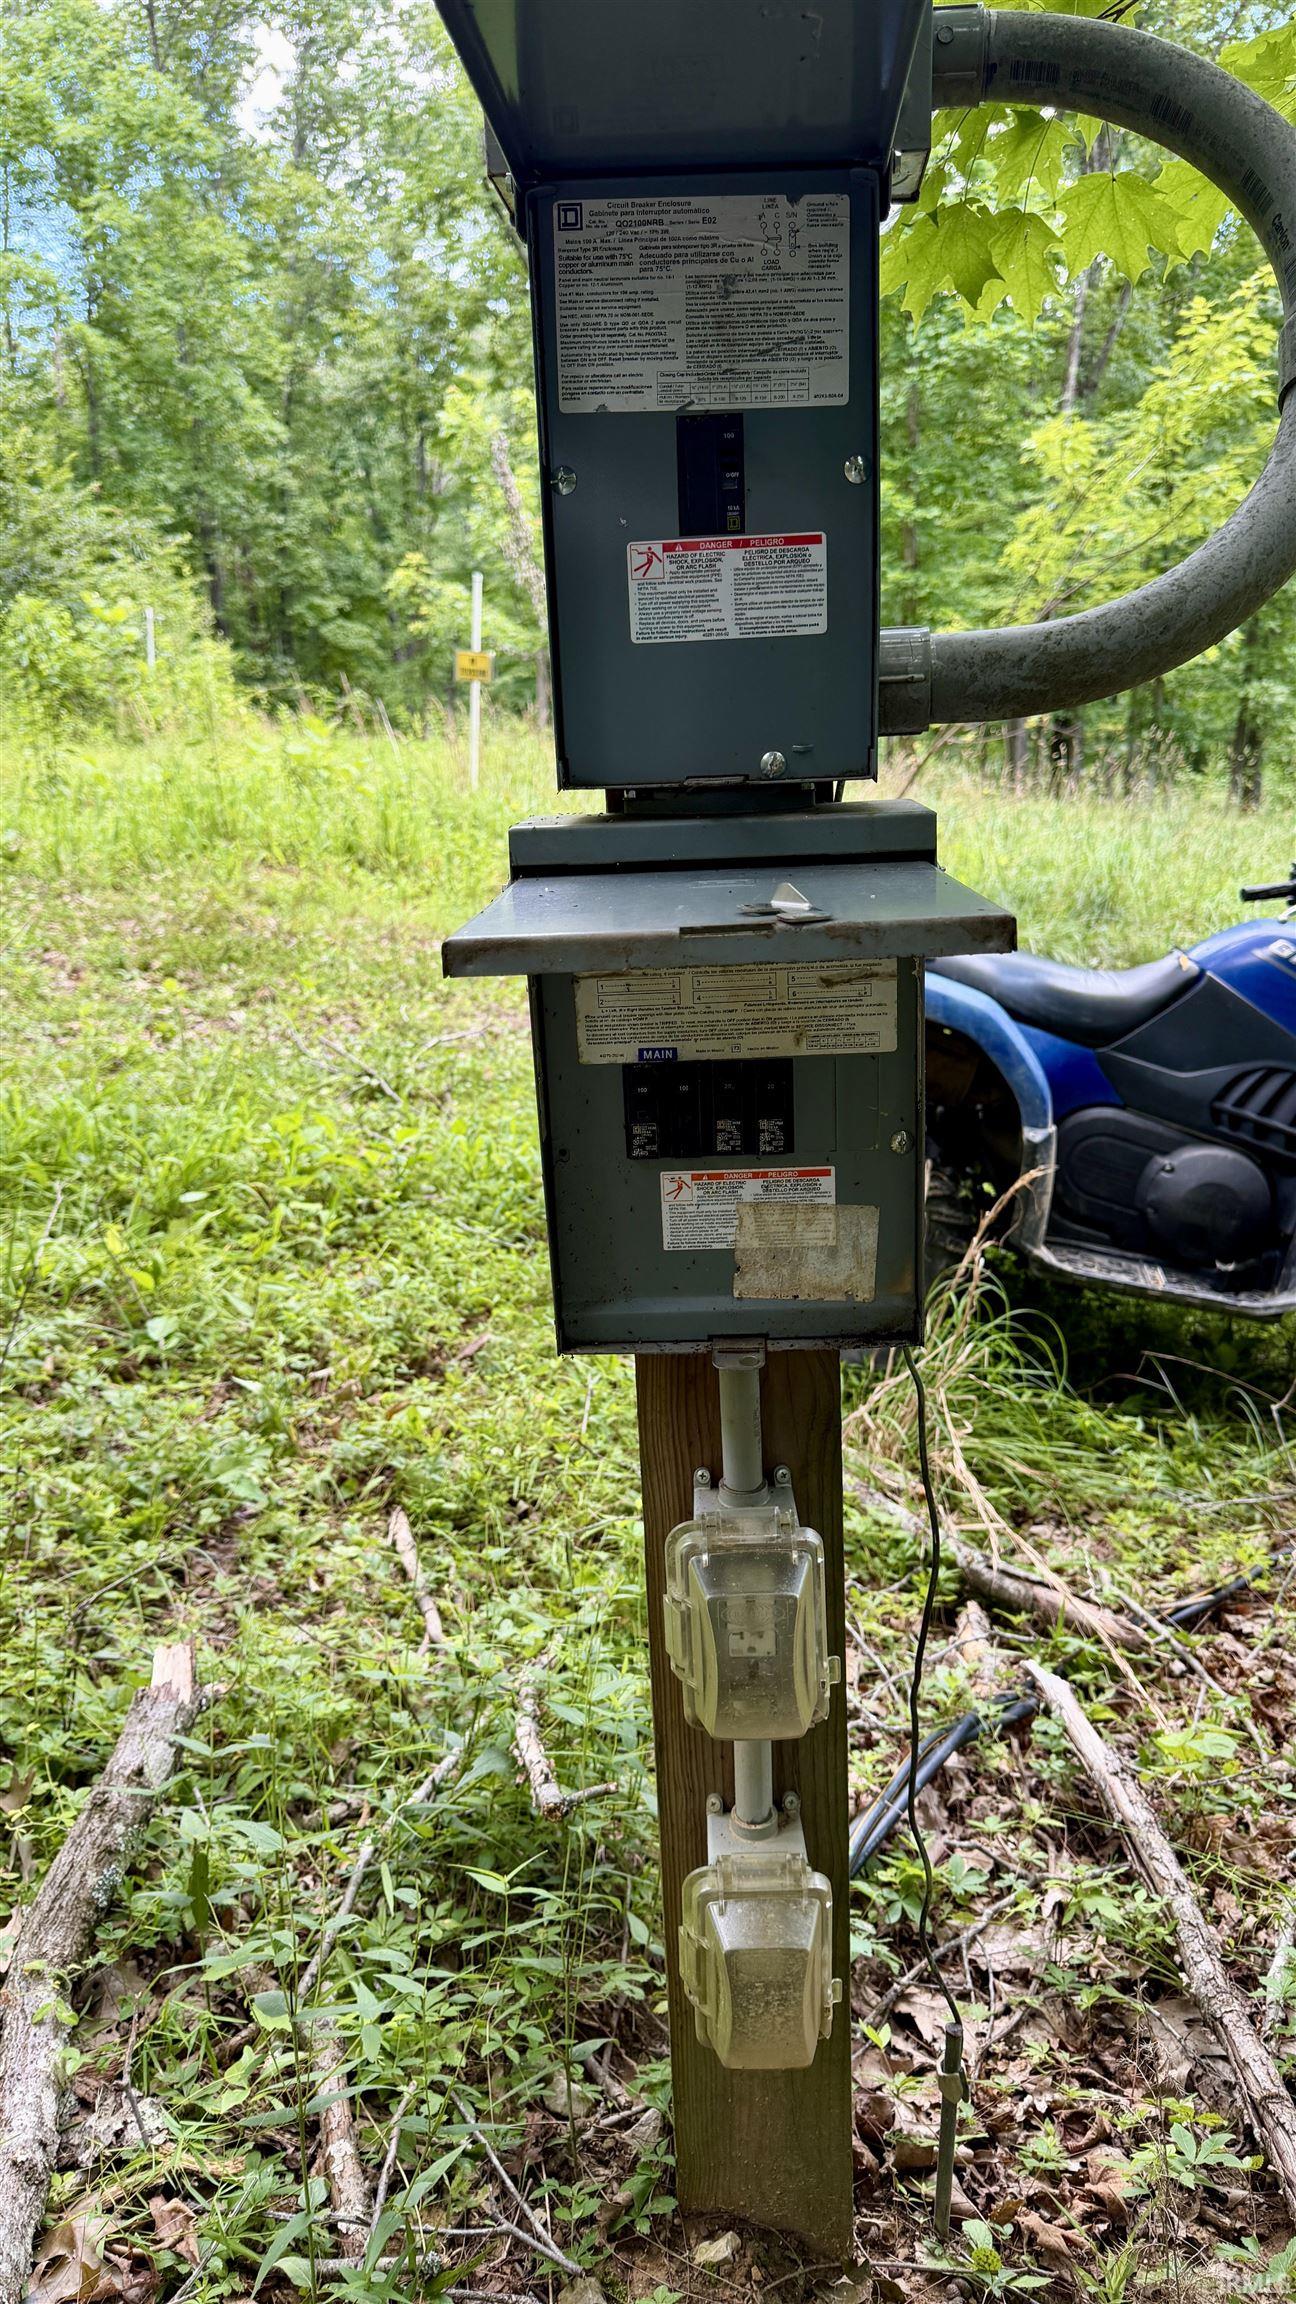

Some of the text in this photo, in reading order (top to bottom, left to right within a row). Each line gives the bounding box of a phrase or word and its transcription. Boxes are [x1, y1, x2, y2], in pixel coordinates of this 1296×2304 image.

[620, 210, 635, 218] para
[615, 219, 664, 228] QO2100NRB
[702, 216, 718, 225] E02
[673, 252, 689, 260] para
[699, 540, 733, 550] DANGER
[750, 538, 785, 547] PELIGRO
[643, 1050, 673, 1060] MAIN
[723, 1172, 753, 1180] DANGER
